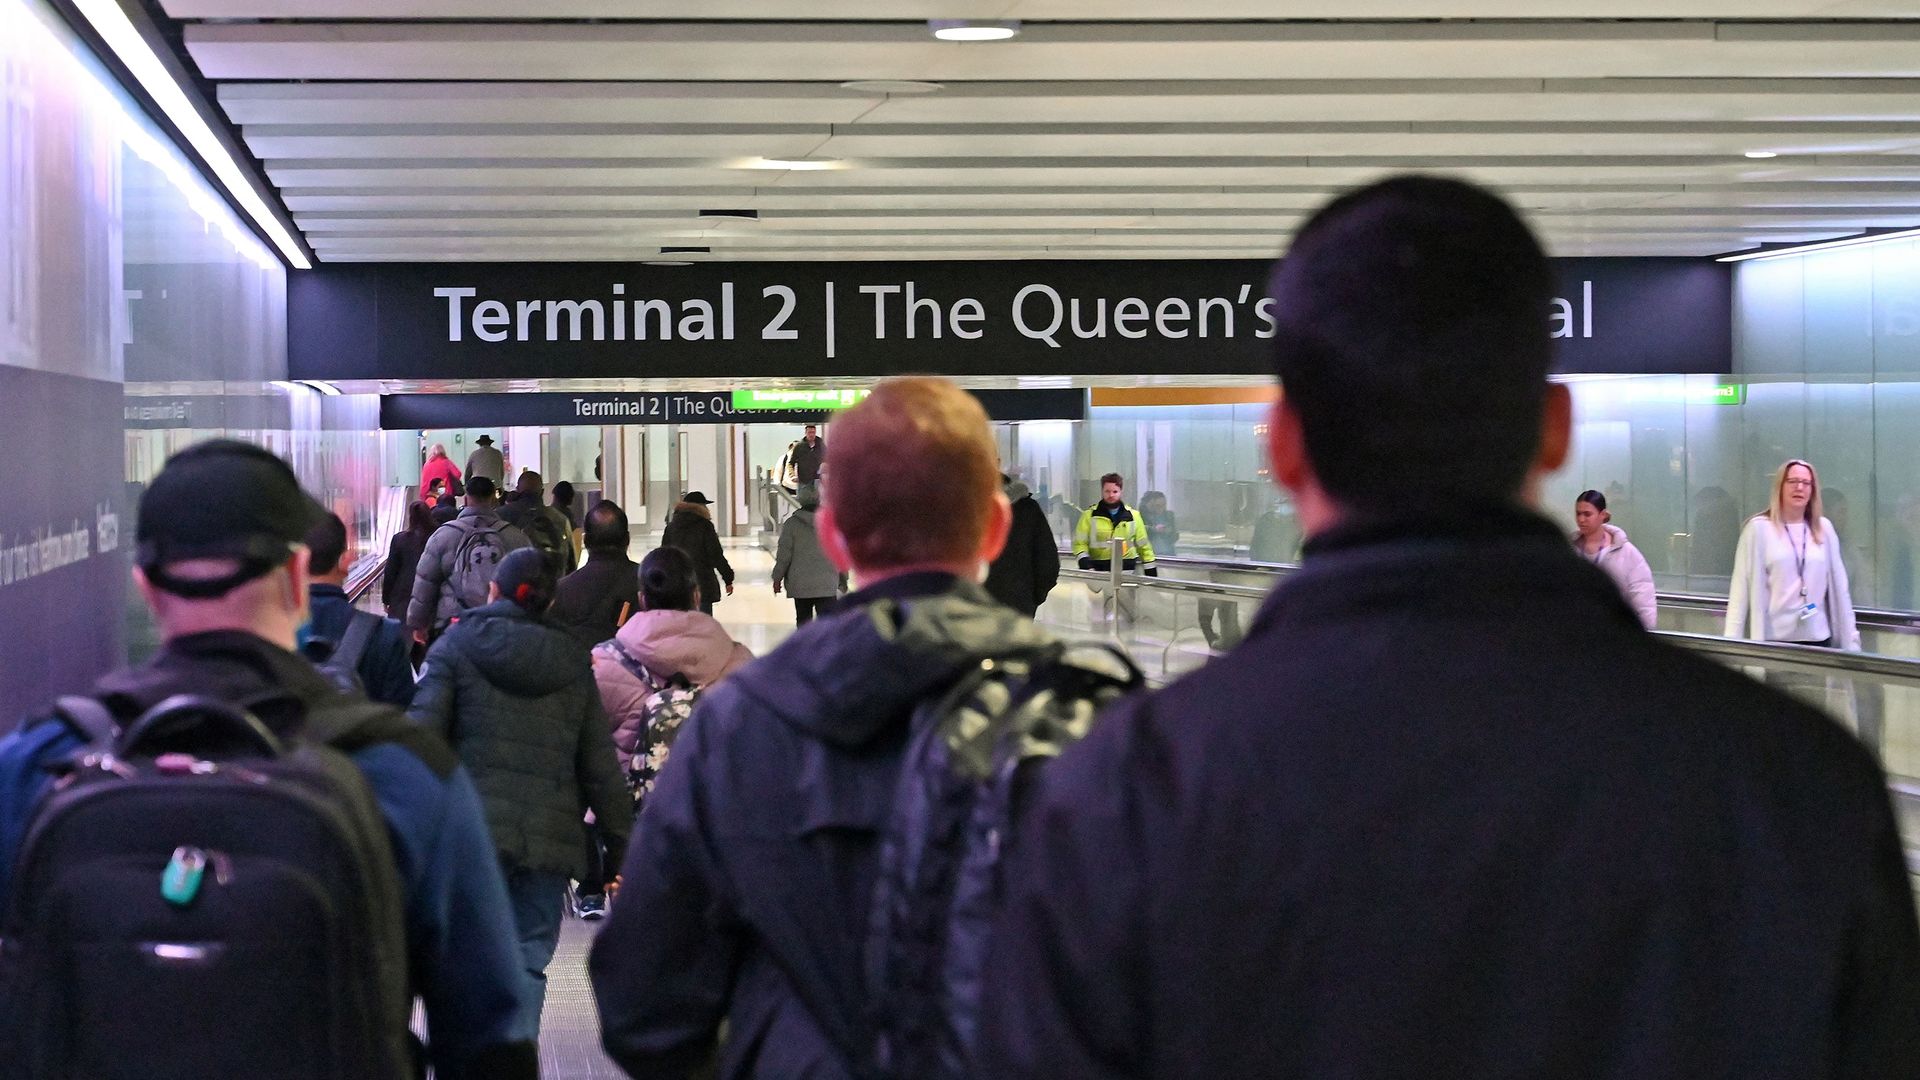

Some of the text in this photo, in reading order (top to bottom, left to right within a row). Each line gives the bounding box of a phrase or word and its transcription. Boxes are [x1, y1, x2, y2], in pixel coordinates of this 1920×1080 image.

[433, 281, 1278, 348] Terminal 2 The Queen’s
[573, 396, 644, 416] Terminal
[649, 397, 660, 415] 2
[673, 396, 705, 415] The
